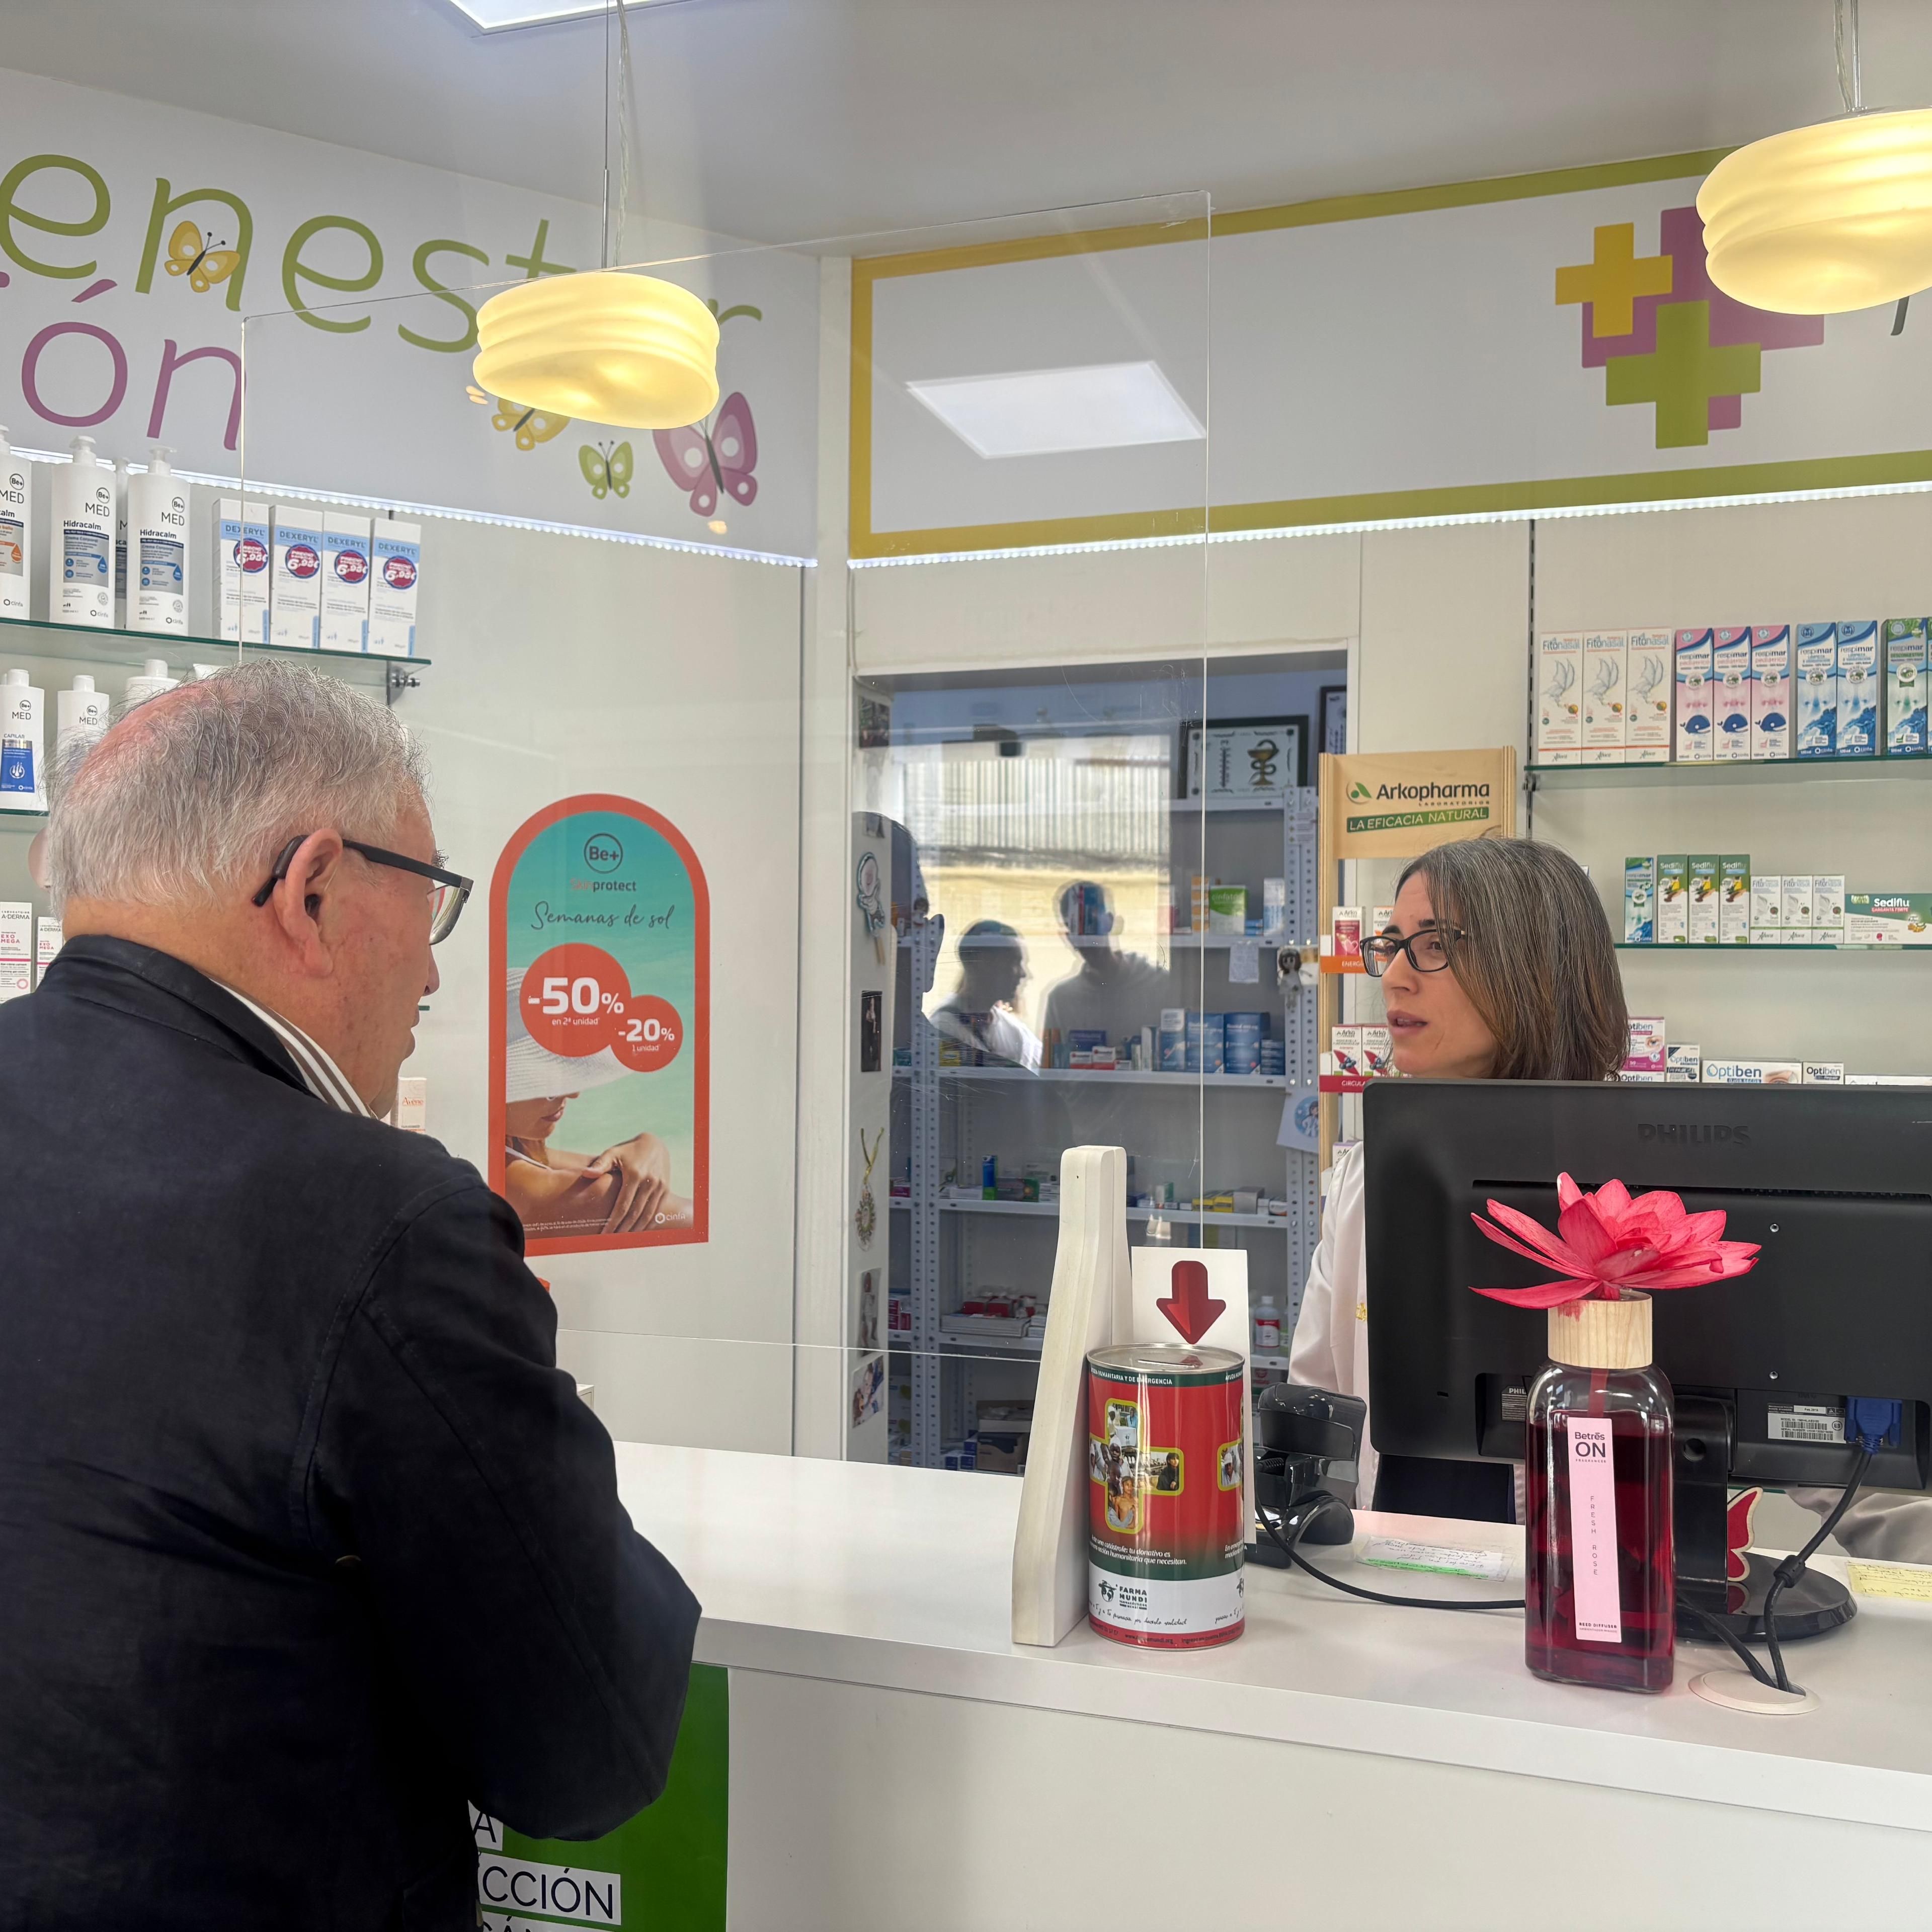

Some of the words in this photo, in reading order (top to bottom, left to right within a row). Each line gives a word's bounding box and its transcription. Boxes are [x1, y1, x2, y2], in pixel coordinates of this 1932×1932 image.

[86, 502, 110, 517] MED
[161, 512, 185, 526] MED
[63, 520, 102, 531] Hidracalm
[140, 529, 177, 539] Hidracalm
[280, 531, 318, 543] DEXERYL
[328, 536, 365, 548] DEXERYL
[378, 542, 416, 555] DEXERYL
[1755, 650, 1786, 658] respimar
[1800, 647, 1832, 655] respimar
[1840, 646, 1874, 654] respimar
[1890, 644, 1923, 652] respimar
[12, 711, 31, 720] MED
[79, 716, 98, 725] MED
[1377, 782, 1490, 801] Arkopharma
[1349, 820, 1365, 831] LA
[1367, 815, 1424, 829] EFICACIA
[1428, 808, 1487, 822] NATURAL
[589, 846, 619, 861] Be+
[1874, 898, 1910, 907] Sediflu
[531, 901, 619, 930] Semanas
[624, 904, 645, 927] de
[649, 904, 675, 929] sol
[528, 977, 624, 1014] -50%
[618, 1019, 675, 1041] -20%
[1670, 1056, 1698, 1065] Optiben
[1706, 1064, 1762, 1080] Optiben
[1806, 1066, 1841, 1076] Optiben
[1638, 1123, 1751, 1146] PHILIPS
[666, 1212, 686, 1221] cinfa
[1575, 1441, 1606, 1458] ON
[1110, 1551, 1143, 1563] humanitaria
[1136, 1548, 1163, 1557] donativo
[1119, 1586, 1147, 1596] FARMA
[1119, 1593, 1147, 1603] MUNDI
[482, 1867, 613, 1919] CCIÓN
